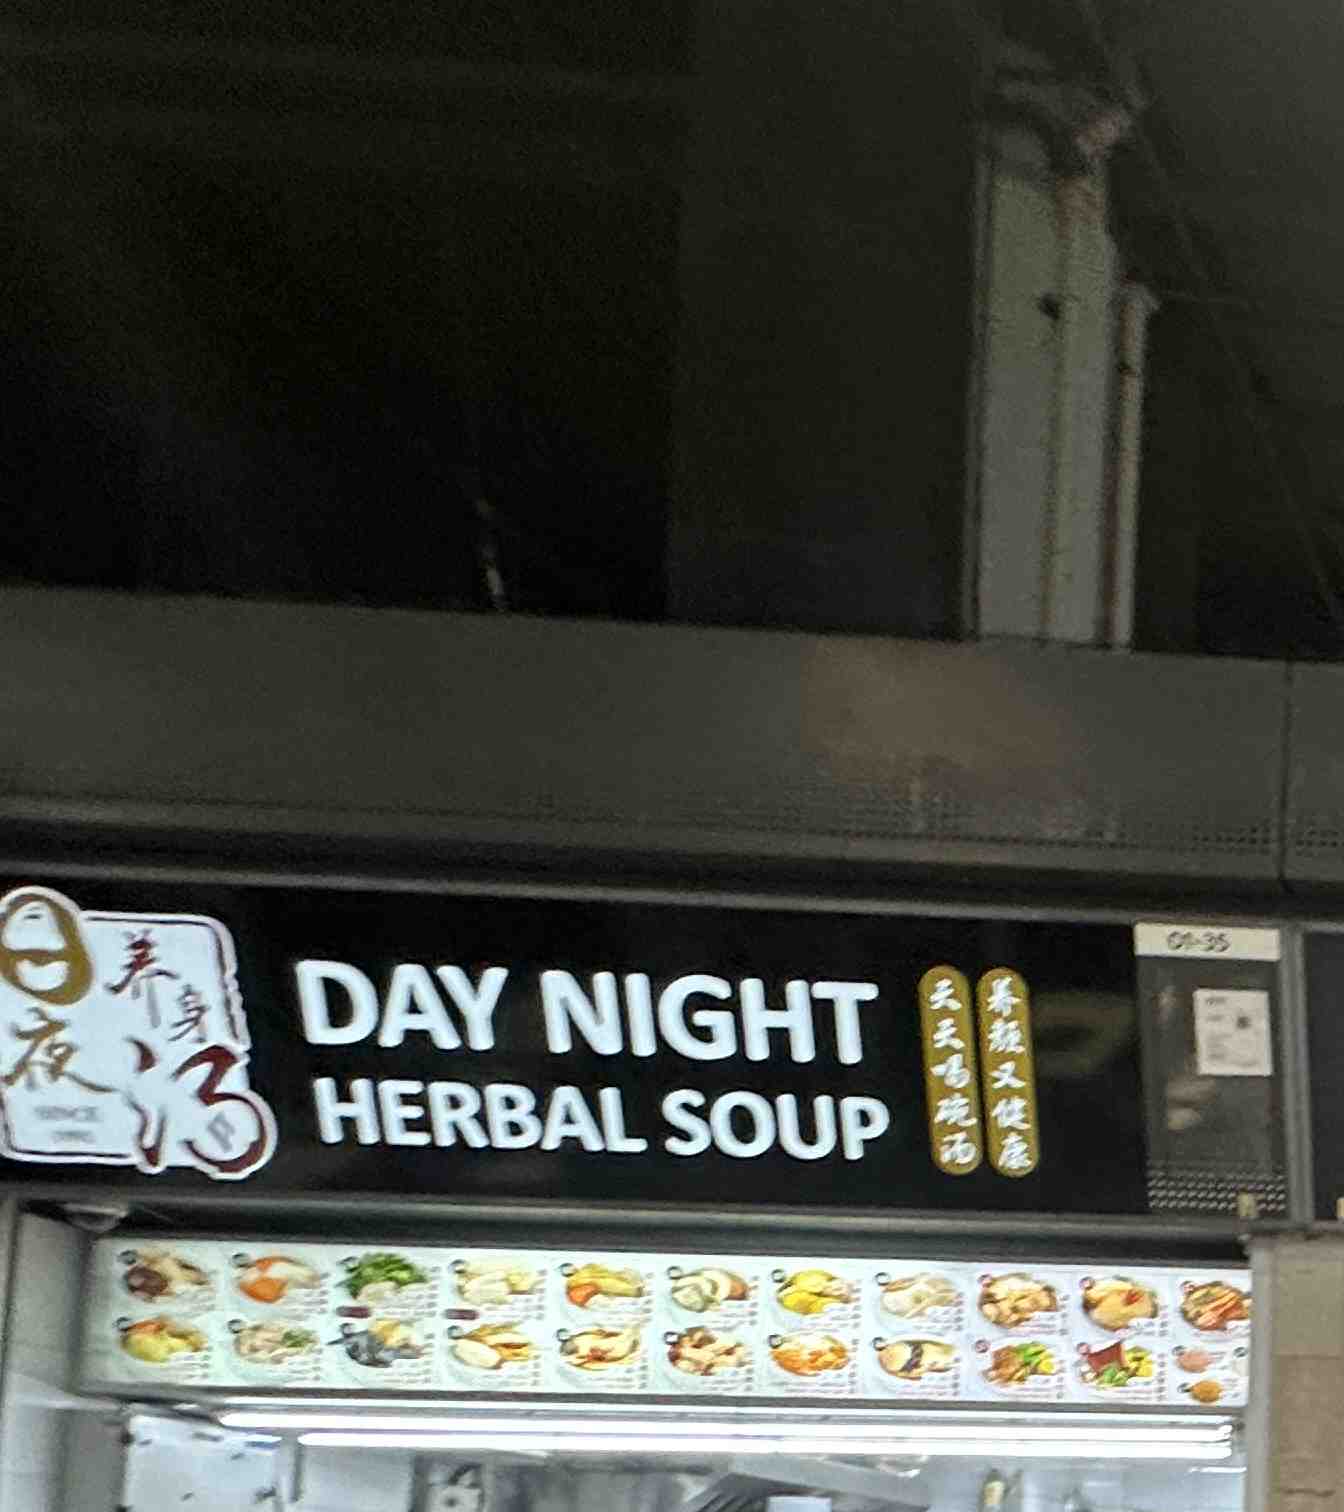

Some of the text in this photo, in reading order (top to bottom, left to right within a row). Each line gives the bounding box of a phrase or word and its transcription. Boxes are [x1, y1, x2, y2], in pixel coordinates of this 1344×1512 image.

[294, 958, 880, 1066] DAY NIGHT
[311, 1076, 649, 1154] HERBAL
[660, 1087, 891, 1162] SOUP
